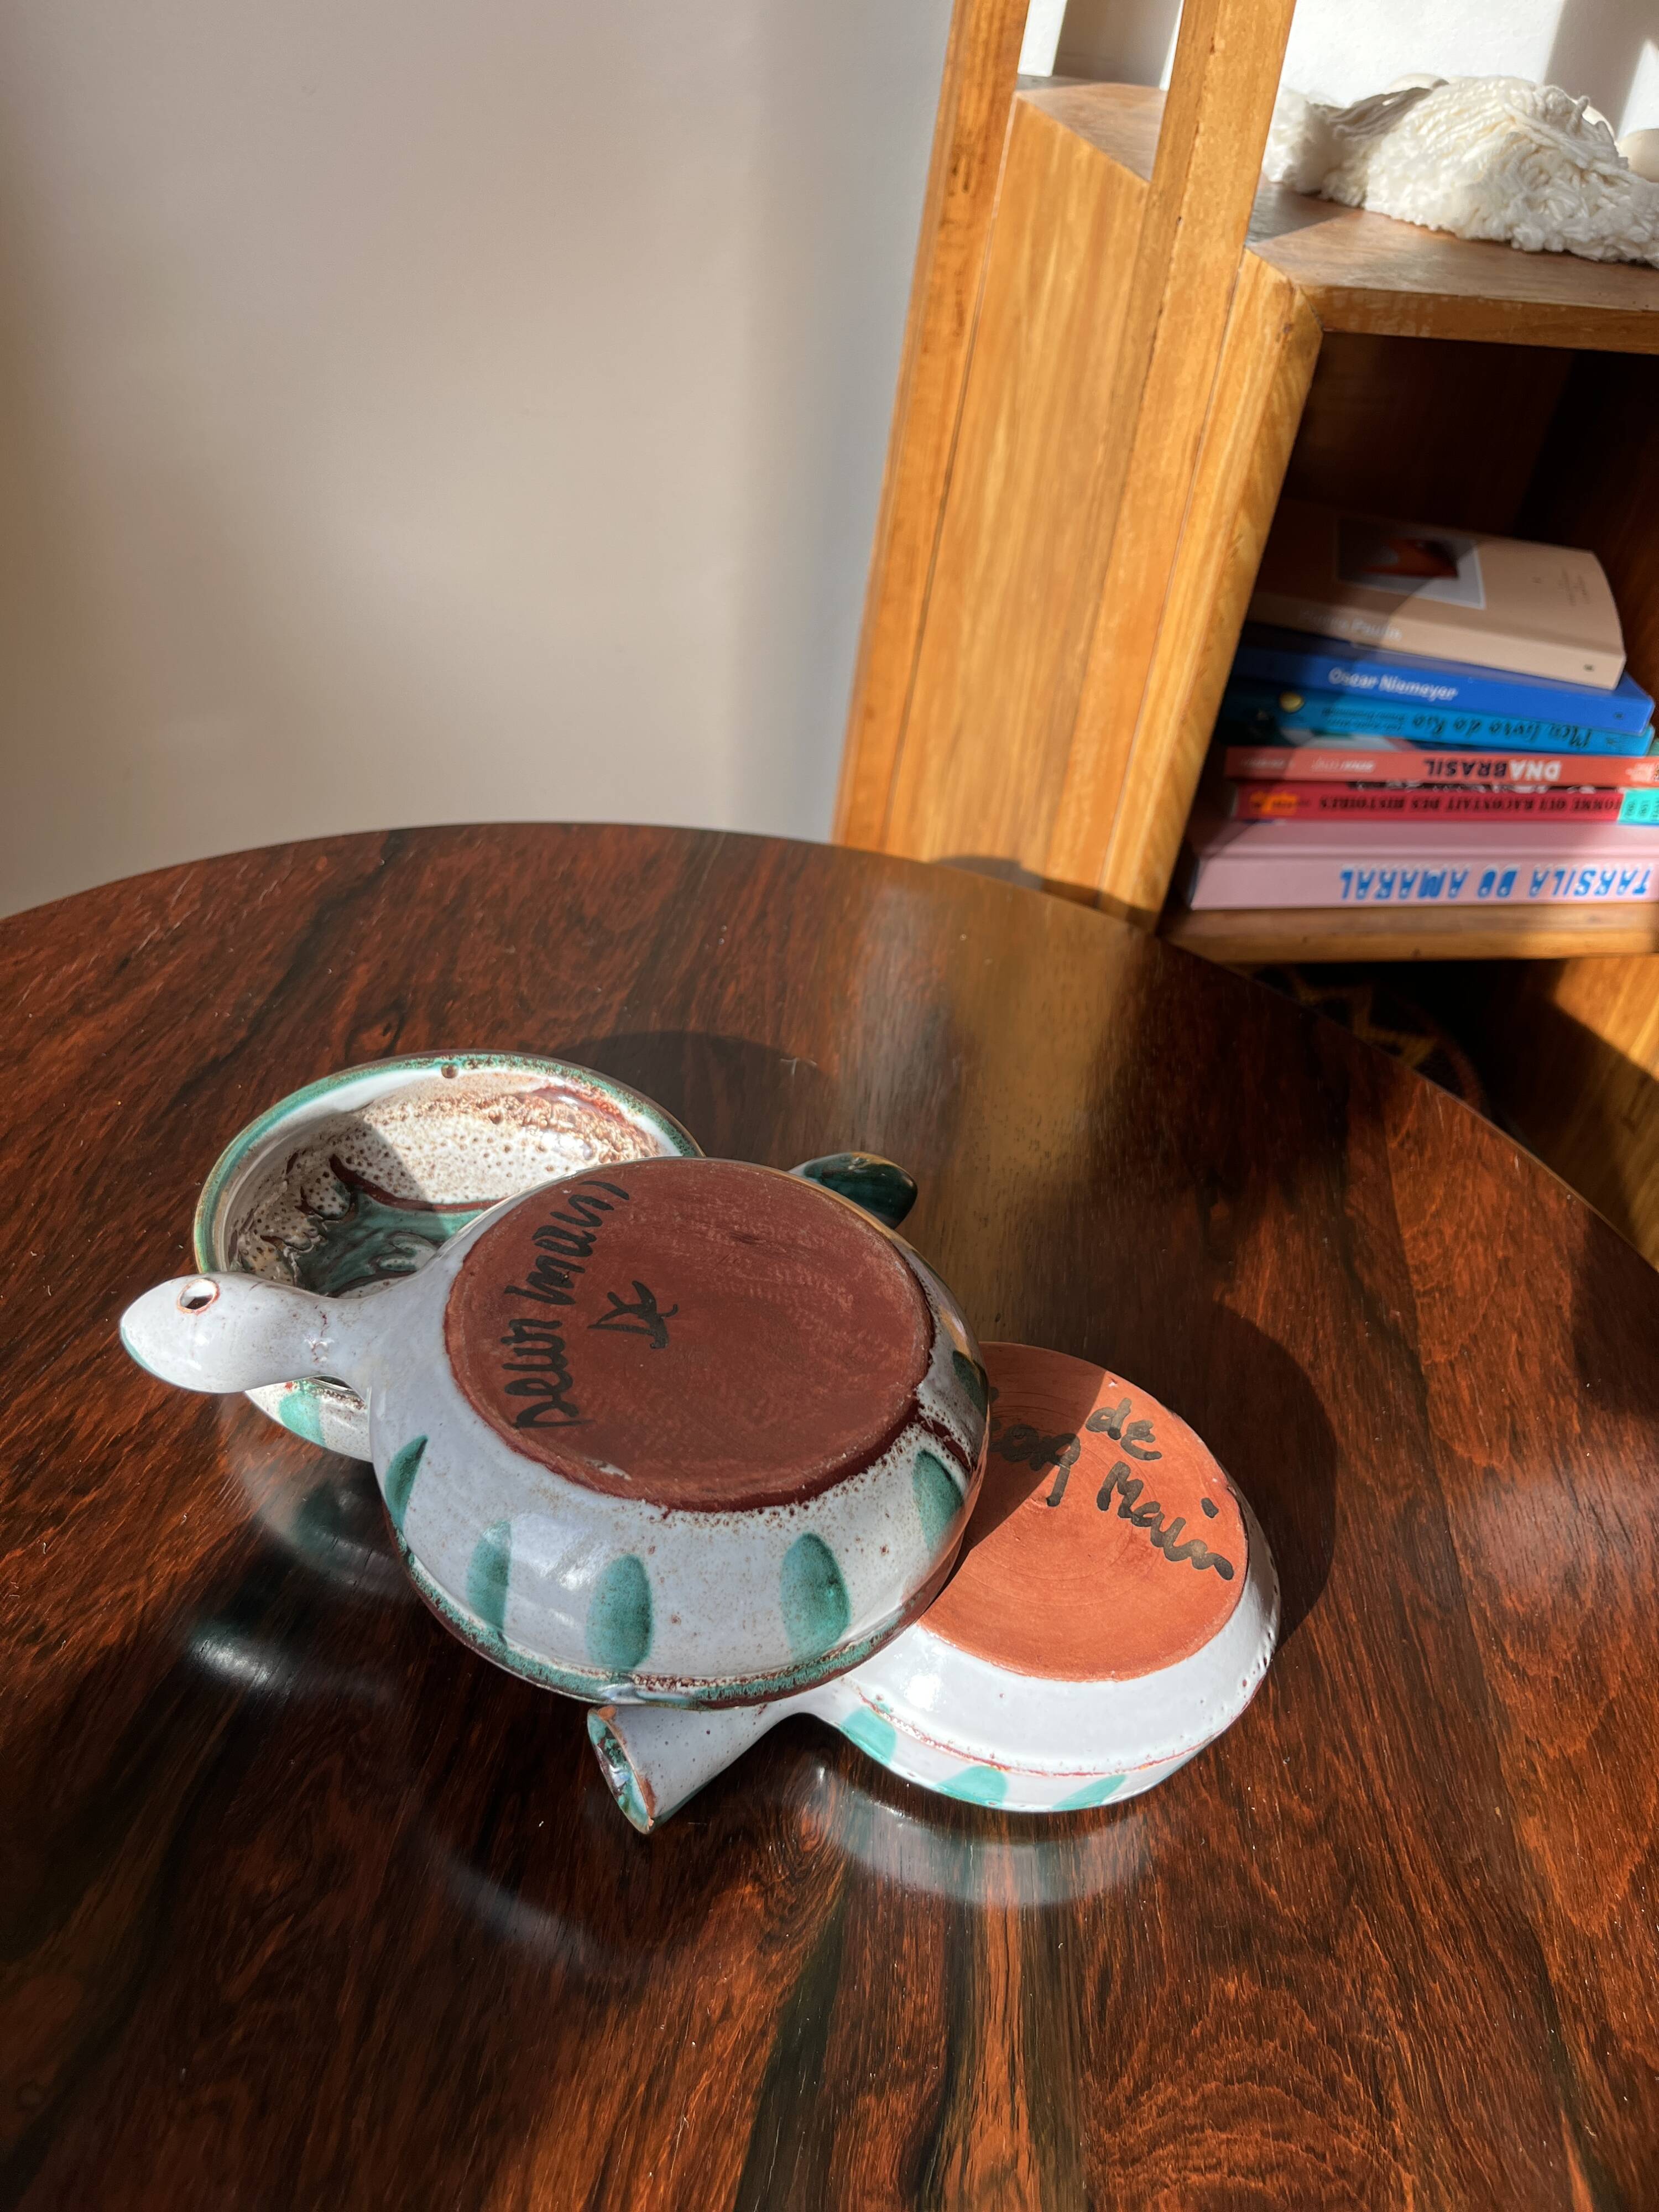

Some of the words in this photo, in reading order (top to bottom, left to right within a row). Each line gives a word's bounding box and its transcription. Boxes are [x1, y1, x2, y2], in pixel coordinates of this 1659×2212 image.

[1328, 666, 1379, 690] Oscar
[1379, 674, 1459, 701] Niemeyer
[1339, 868, 1469, 900] AMARAL
[1477, 868, 1519, 899] DO
[1528, 867, 1651, 897] TARSILA
